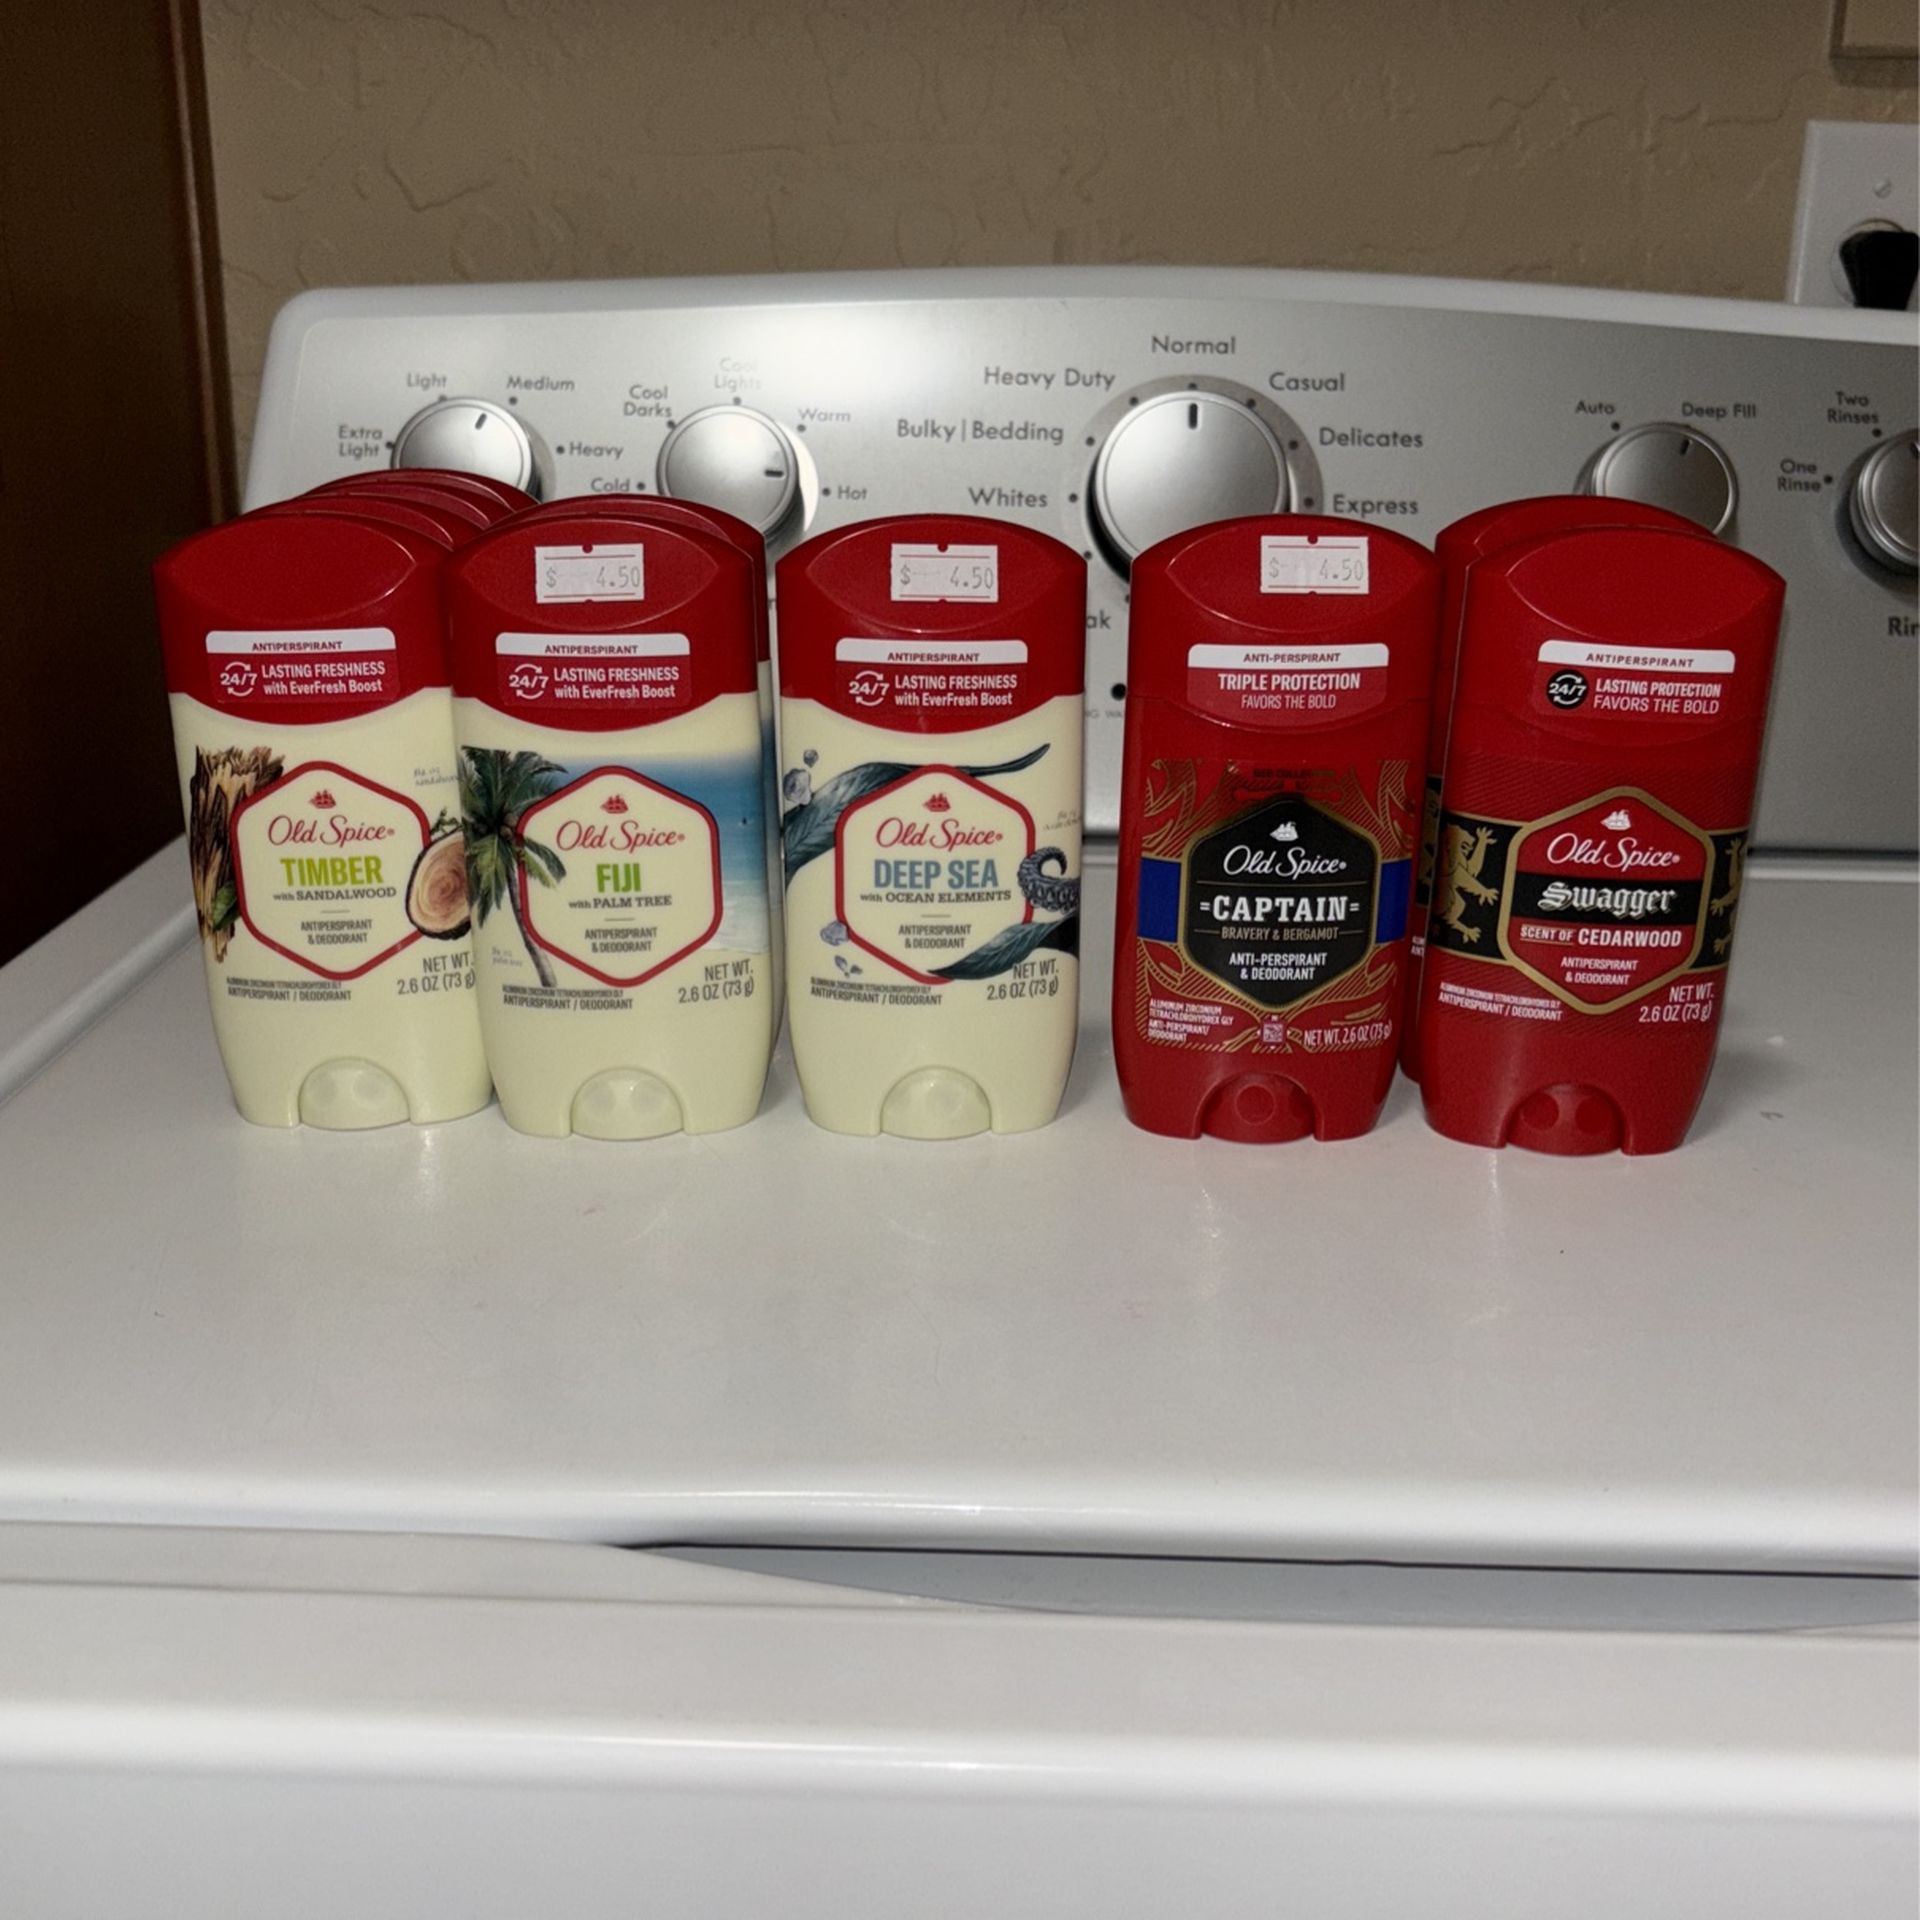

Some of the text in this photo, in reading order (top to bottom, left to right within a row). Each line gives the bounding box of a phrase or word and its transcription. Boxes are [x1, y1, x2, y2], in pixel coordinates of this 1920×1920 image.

[1151, 335, 1236, 356] Normal
[407, 373, 447, 391] Light
[507, 375, 575, 391] Medium
[713, 374, 761, 393] Lights
[984, 367, 1116, 390] Heavy Duty
[1269, 372, 1346, 392] Casual
[629, 384, 668, 400] Cool
[1836, 392, 1870, 407] Two
[623, 401, 672, 418] Darks
[798, 408, 851, 423] Warm
[1575, 401, 1615, 415] Auto
[1682, 403, 1756, 419] Deep Fill
[1827, 409, 1879, 424] Rinses
[338, 425, 382, 441] Extra
[1319, 428, 1423, 448] Delicates
[339, 442, 380, 460] Light
[569, 442, 624, 459] Heavy
[1780, 459, 1817, 474] One
[591, 478, 630, 493] Cold
[837, 485, 868, 500] Hot
[1778, 477, 1821, 492] Rinse
[968, 488, 1048, 508] Whites
[1334, 495, 1419, 518] Express
[546, 566, 641, 588] $ 4.50
[900, 566, 993, 588] $ 4.50
[1269, 557, 1364, 581] $ 4.50
[252, 641, 343, 651] ANTIPERSPIRANT
[545, 645, 638, 654] ANTIPERSPIRANT
[887, 652, 980, 662] ANTIPERSPIRANT
[1243, 653, 1341, 663] ANTI-PERSPIRANT
[1586, 653, 1694, 667] ANTIPERSPIRANT
[261, 661, 385, 678] LASTING FRESHNESS
[554, 667, 679, 682] LASTING FRESHNESS
[220, 673, 257, 686] 24/7
[264, 679, 382, 695] with EverFresh Boost
[509, 675, 548, 688] 24/7
[895, 675, 1017, 689] LASTING FRESHNESS
[1218, 673, 1361, 691] TRIPLE PROTECTION
[1596, 678, 1721, 697] LASTING PROTECTION
[555, 684, 675, 699] with EverFresh Boost
[849, 682, 889, 695] 24/7
[1549, 683, 1586, 696] 24/7
[895, 692, 1012, 706] with EverFresh Boost
[1241, 694, 1336, 709] FAVORS THE BOLD
[1594, 695, 1719, 714] FAVORS THE BOLD
[268, 815, 387, 848] Old Spice
[556, 820, 678, 854] Old Spice
[876, 818, 995, 852] Old Spice
[1547, 833, 1672, 872] Old Spice
[1223, 844, 1340, 880] Old Spice
[280, 856, 383, 886] TIMBER
[596, 863, 641, 892] FIJI
[874, 859, 998, 888] DEEP SEA
[273, 887, 396, 901] with SANDALWOOD
[568, 896, 672, 908] with PALM TREE
[860, 890, 1011, 903] with OCEAN ELEMENTS
[1537, 881, 1677, 920] Swagger
[1212, 895, 1348, 922] CAPTAIN
[301, 920, 372, 932] ANTIPERSPIRANT
[585, 928, 658, 940] ANTIPERSPIRANT
[899, 924, 972, 936] ANTIPERSPIRANT
[1221, 926, 1340, 941] BRAVERY & BERGAMOT
[308, 932, 368, 944] & DEODORANT
[905, 938, 965, 950] & DEODORANT
[1520, 926, 1682, 947] SCENT OF CEDARWOOD
[592, 941, 652, 954] & DEODORANT
[423, 956, 448, 973] NET
[450, 952, 473, 969] WT.
[1229, 953, 1327, 966] ANTI-PERSPIRANT
[1561, 956, 1638, 971] ANTIPERSPIRANT
[704, 960, 754, 982] NET WT.
[1013, 959, 1059, 978] NET WT.
[1240, 968, 1315, 980] & DEODORANT
[397, 972, 476, 996] 2.6 OZ (73 g)
[1565, 972, 1630, 985] & DEODORANT
[678, 978, 754, 1004] 2.6 OZ (73 g)
[987, 976, 1058, 1000] 2.6 OZ (73 g)
[1669, 983, 1714, 1002] NET WT.
[1151, 999, 1222, 1015] ALUMINUM ZIRCONIUM
[1439, 991, 1504, 1015] ANTIPERSPIRANT
[1511, 1005, 1562, 1021] DEODORANT
[1639, 1002, 1712, 1023] 2.6 OZ (73 g)
[1221, 1016, 1233, 1025] GLY
[1148, 1030, 1187, 1042] DEODORANT
[1304, 1029, 1322, 1046] NET
[1324, 1028, 1340, 1045] WT.
[1358, 1026, 1368, 1042] OZ
[1369, 1025, 1382, 1040] (73
